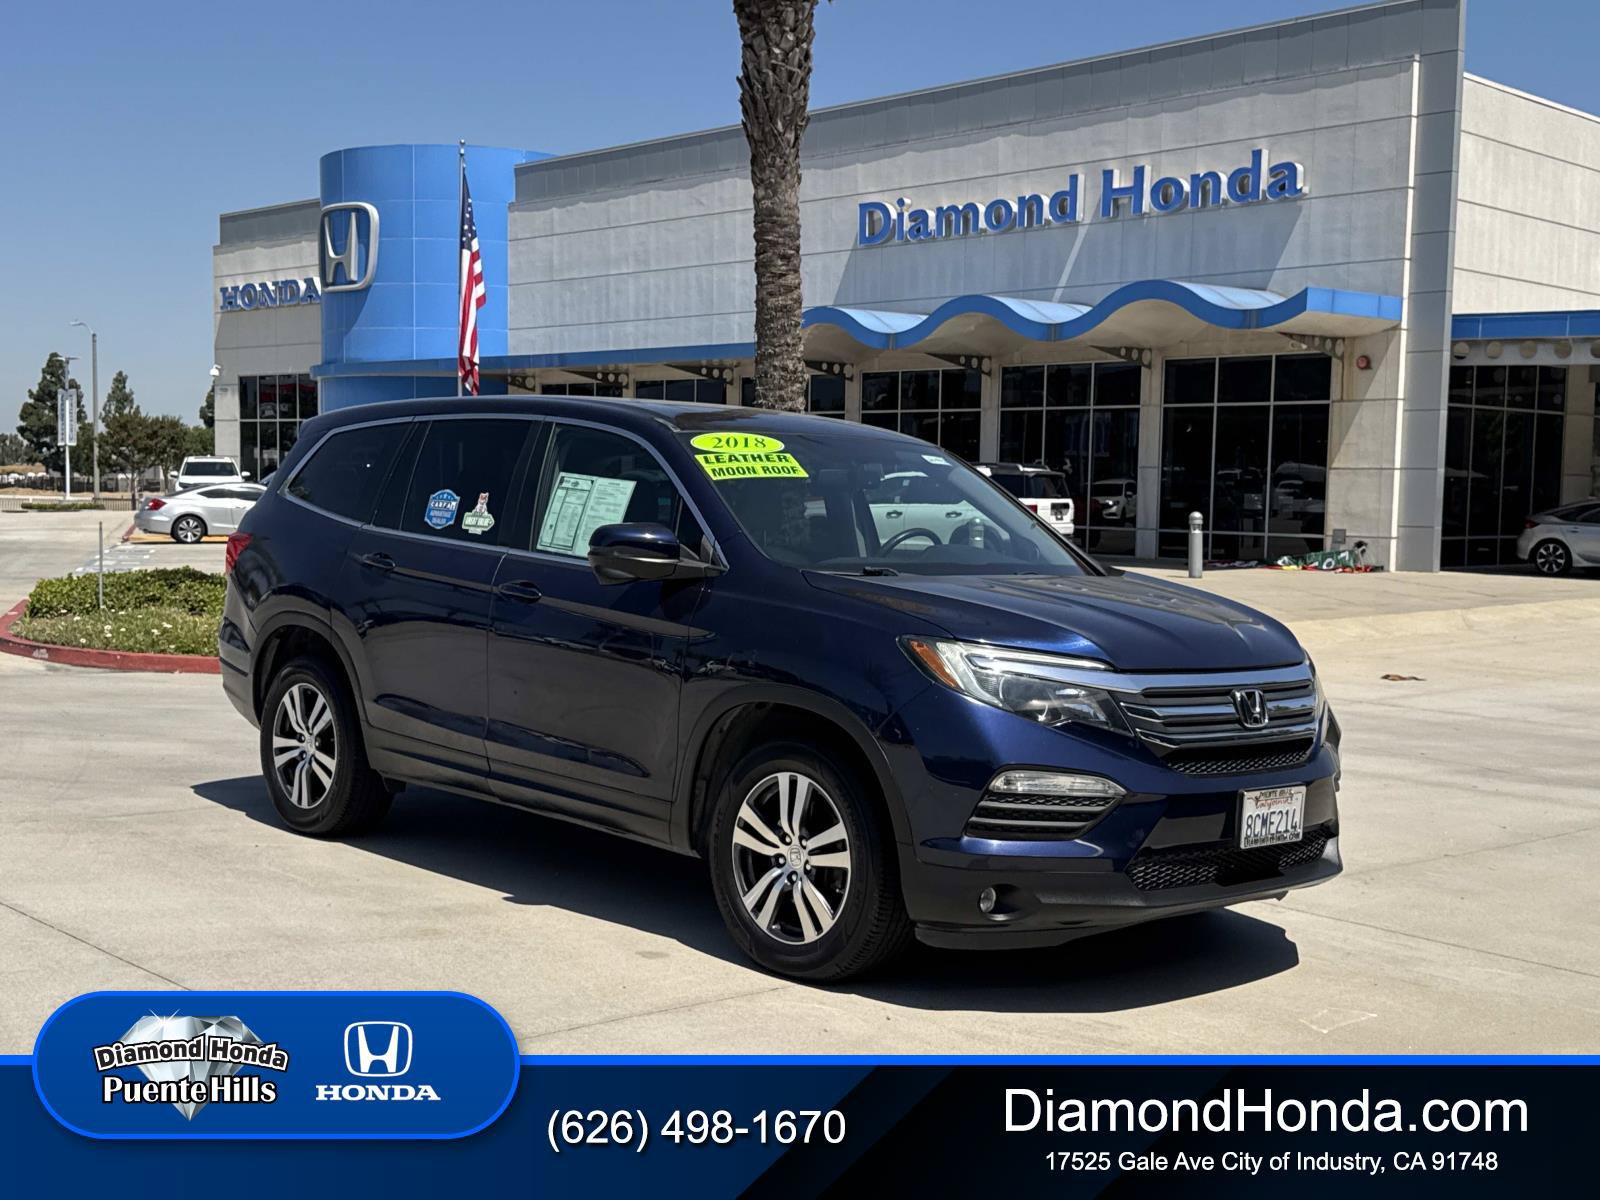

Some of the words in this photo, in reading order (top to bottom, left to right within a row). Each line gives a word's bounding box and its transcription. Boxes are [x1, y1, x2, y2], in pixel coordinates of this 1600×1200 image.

[858, 173, 1080, 246] Diamond
[1101, 148, 1304, 218] Honda
[219, 277, 321, 310] HONDA
[712, 437, 767, 449] 2018
[703, 454, 790, 465] LEATHER
[711, 466, 757, 477] MOON
[761, 466, 800, 475] ROOF
[1246, 808, 1298, 838] 8CME214
